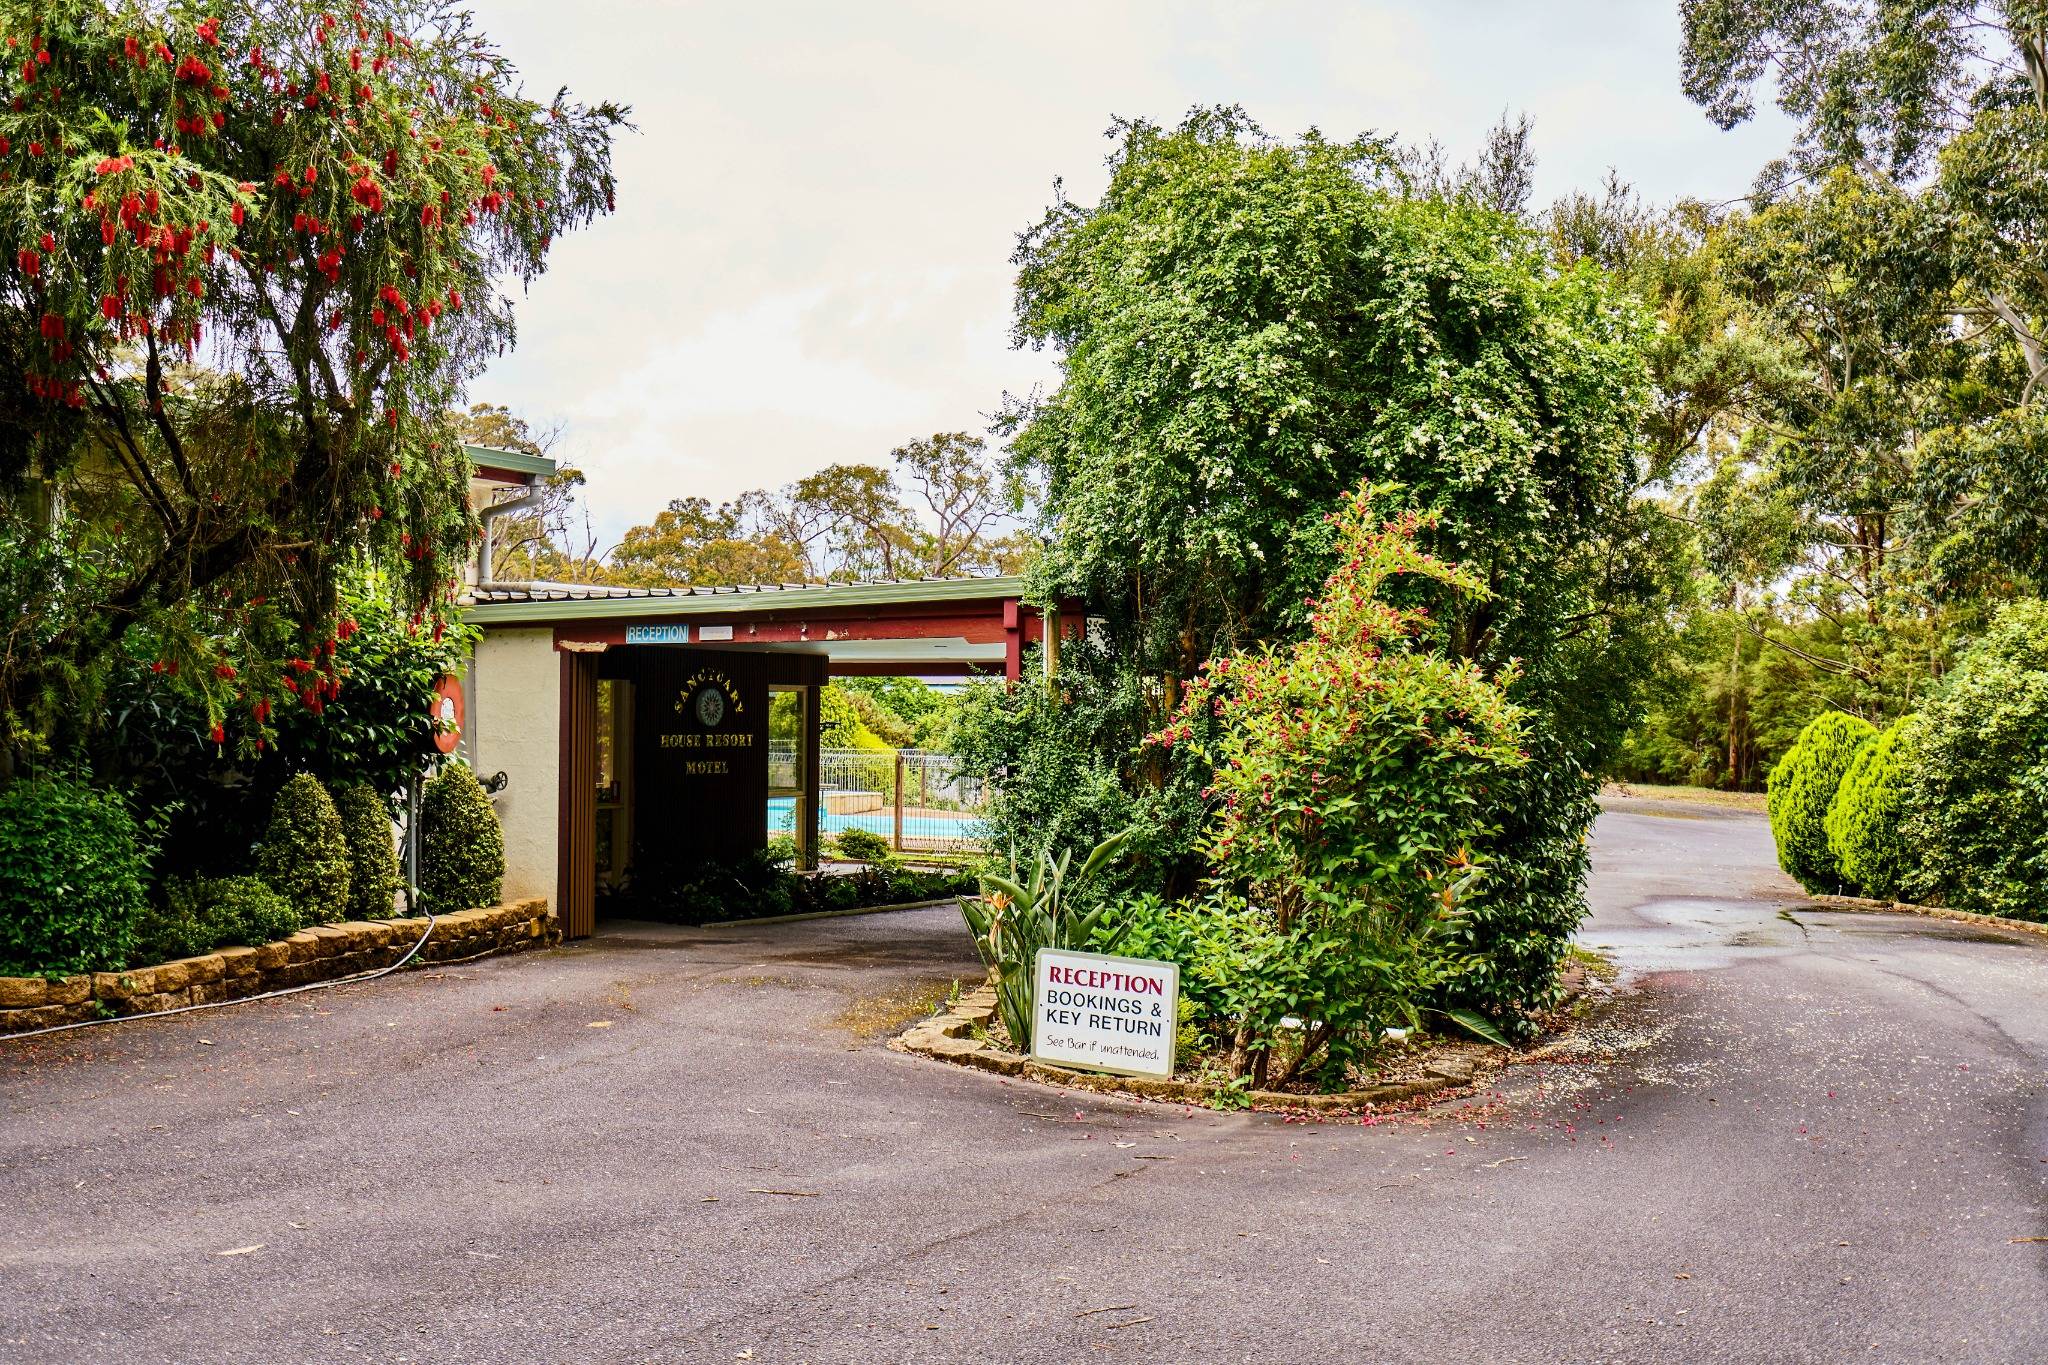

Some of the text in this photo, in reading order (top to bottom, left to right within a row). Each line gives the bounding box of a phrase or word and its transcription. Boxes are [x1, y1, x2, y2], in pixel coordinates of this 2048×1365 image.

[628, 625, 687, 641] RECEPTION
[660, 734, 753, 748] HOUSE RESORT
[686, 761, 729, 775] MOTEL
[1049, 966, 1164, 996] RECEPTION
[1047, 989, 1162, 1018] BOOKINGS &
[1046, 1008, 1162, 1037] KEY RETURN
[1046, 1034, 1159, 1060] See Bar if unattended.
